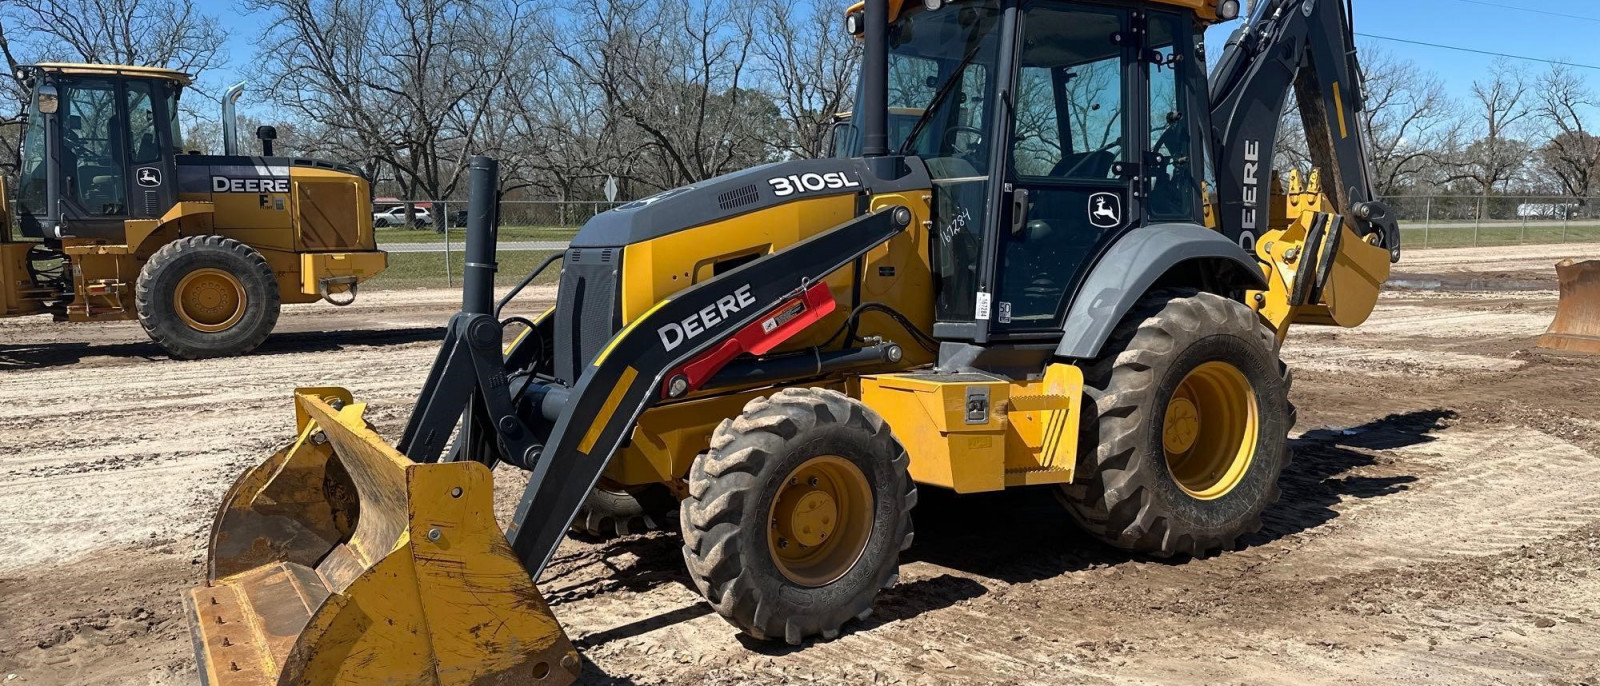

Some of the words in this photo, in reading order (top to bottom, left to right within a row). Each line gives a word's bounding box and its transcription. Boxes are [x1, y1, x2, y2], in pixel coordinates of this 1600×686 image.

[212, 176, 289, 192] DEERE
[768, 171, 859, 196] 310SL
[1239, 140, 1259, 254] DEERE
[940, 207, 971, 247] 167284
[657, 283, 756, 352] DEERE
